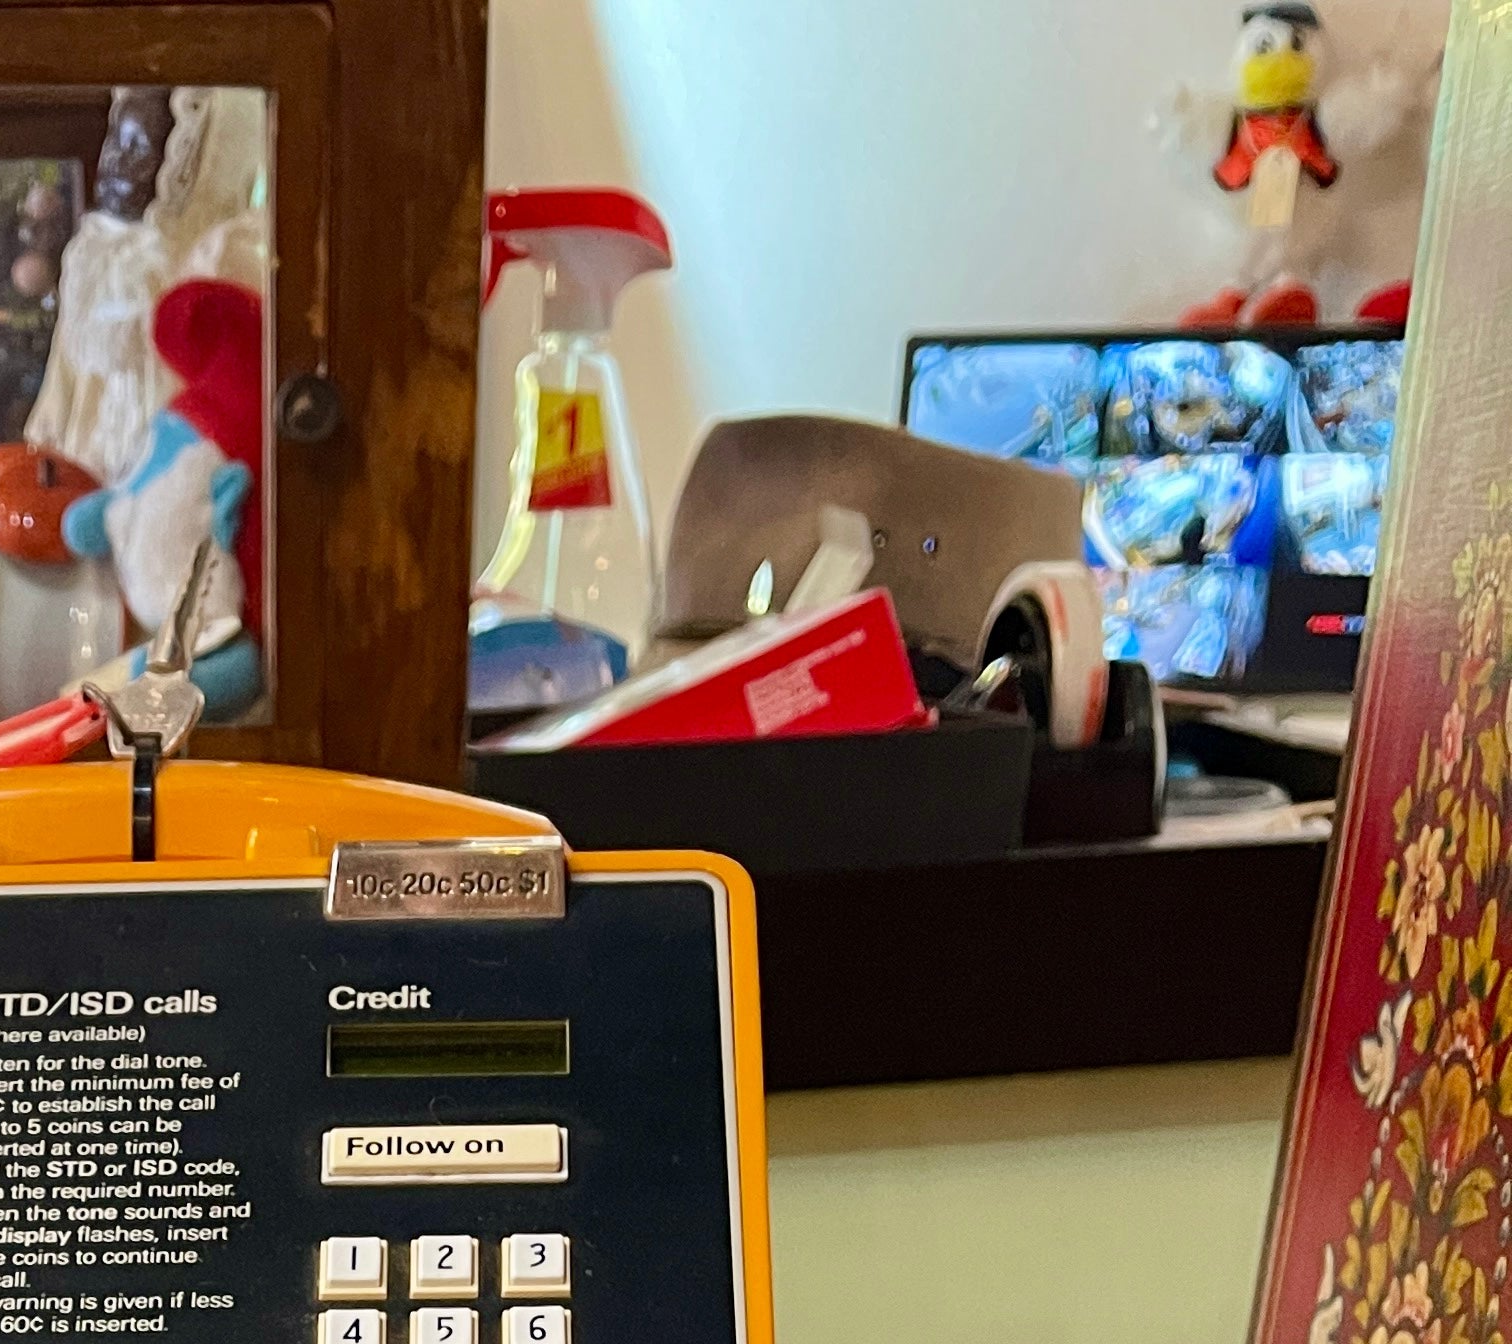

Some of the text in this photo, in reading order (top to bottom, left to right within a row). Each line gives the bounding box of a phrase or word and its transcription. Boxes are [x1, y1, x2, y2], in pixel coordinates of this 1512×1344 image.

[347, 868, 550, 897] 10c 20c 50c $1
[143, 988, 218, 1015] calls
[327, 984, 432, 1010] Credit
[47, 1024, 146, 1044] available)
[35, 1054, 66, 1072] for
[70, 1054, 106, 1071] the
[110, 1052, 149, 1070] dial
[154, 1054, 208, 1069] tone.
[50, 1141, 72, 1157] at
[76, 1142, 119, 1156] one
[124, 1137, 184, 1157] time).
[345, 1135, 505, 1158] Follow on
[4, 1161, 41, 1179] the
[45, 1159, 98, 1179] STD
[103, 1163, 128, 1177] or
[133, 1158, 178, 1177] ISD
[9, 1182, 47, 1200] the
[51, 1180, 142, 1203] required
[147, 1180, 236, 1198] number.
[76, 1224, 160, 1244] flashes,
[167, 1224, 229, 1242] insert
[350, 1242, 546, 1271] 1 2 3
[342, 1314, 547, 1344] 4 5 6
